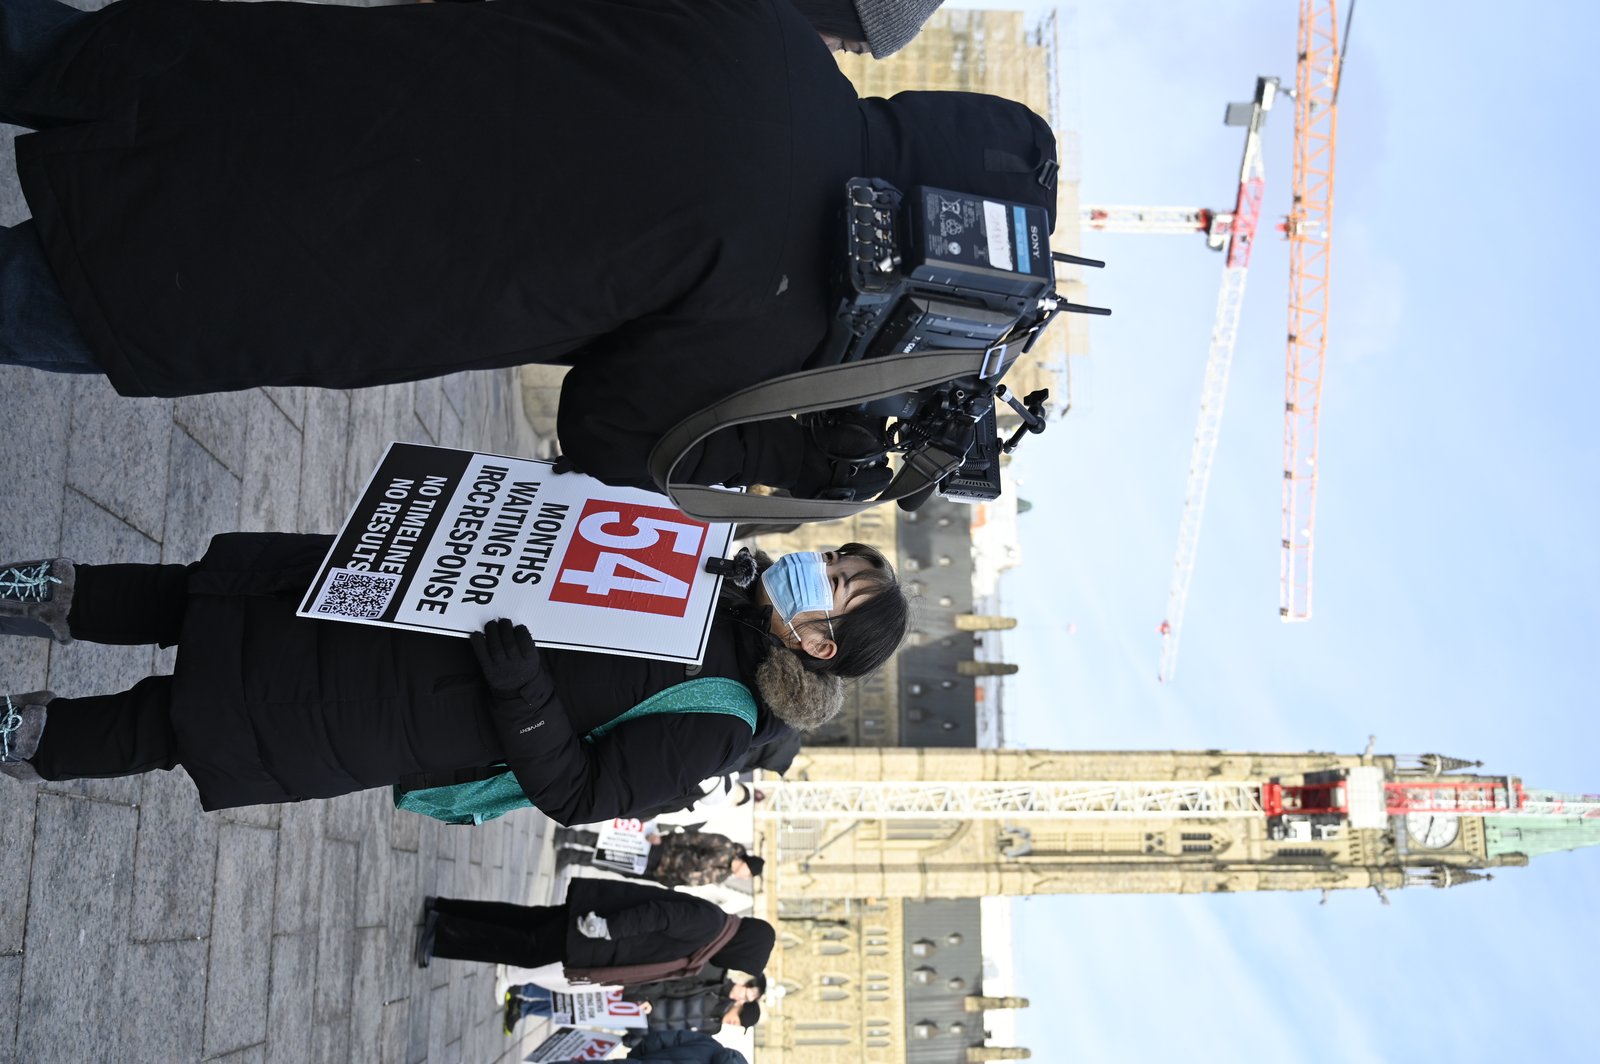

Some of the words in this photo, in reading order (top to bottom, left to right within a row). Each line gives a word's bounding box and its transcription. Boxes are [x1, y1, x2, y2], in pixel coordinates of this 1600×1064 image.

[1031, 225, 1039, 258] SONY
[385, 478, 414, 499] NO
[418, 475, 447, 496] NO
[470, 464, 508, 505] IRCC
[346, 501, 400, 571] RESULTS
[481, 482, 540, 557] WAITING
[511, 502, 569, 585] MONTHS
[416, 506, 490, 614] RESPONSE
[560, 511, 703, 599] 54
[462, 562, 504, 605] FOR
